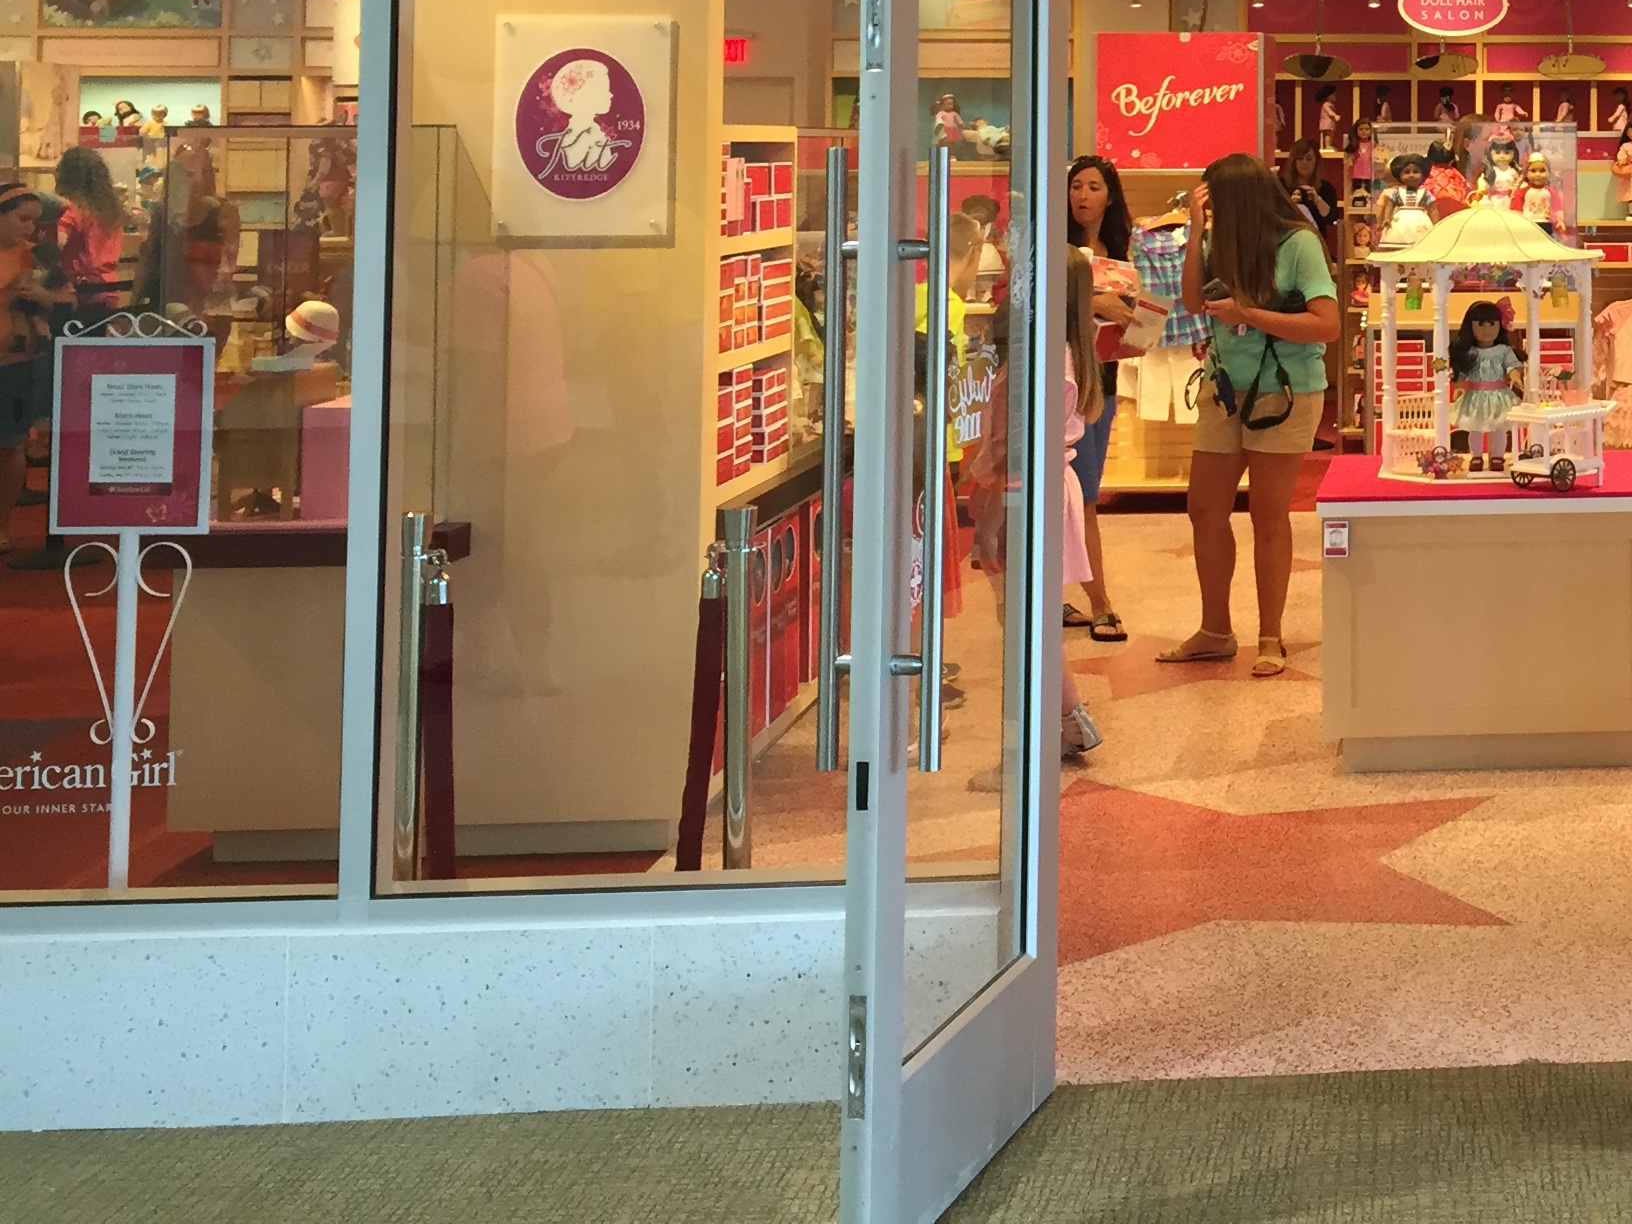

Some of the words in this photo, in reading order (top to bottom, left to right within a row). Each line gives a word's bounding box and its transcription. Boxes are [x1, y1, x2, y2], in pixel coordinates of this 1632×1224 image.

[1421, 10, 1484, 20] SALON
[724, 37, 747, 63] XIT
[1111, 75, 1244, 136] Beforever
[617, 120, 640, 130] 1934
[536, 126, 632, 180] Kit
[554, 173, 609, 181] KITTREDGE
[36, 804, 77, 814] INNER
